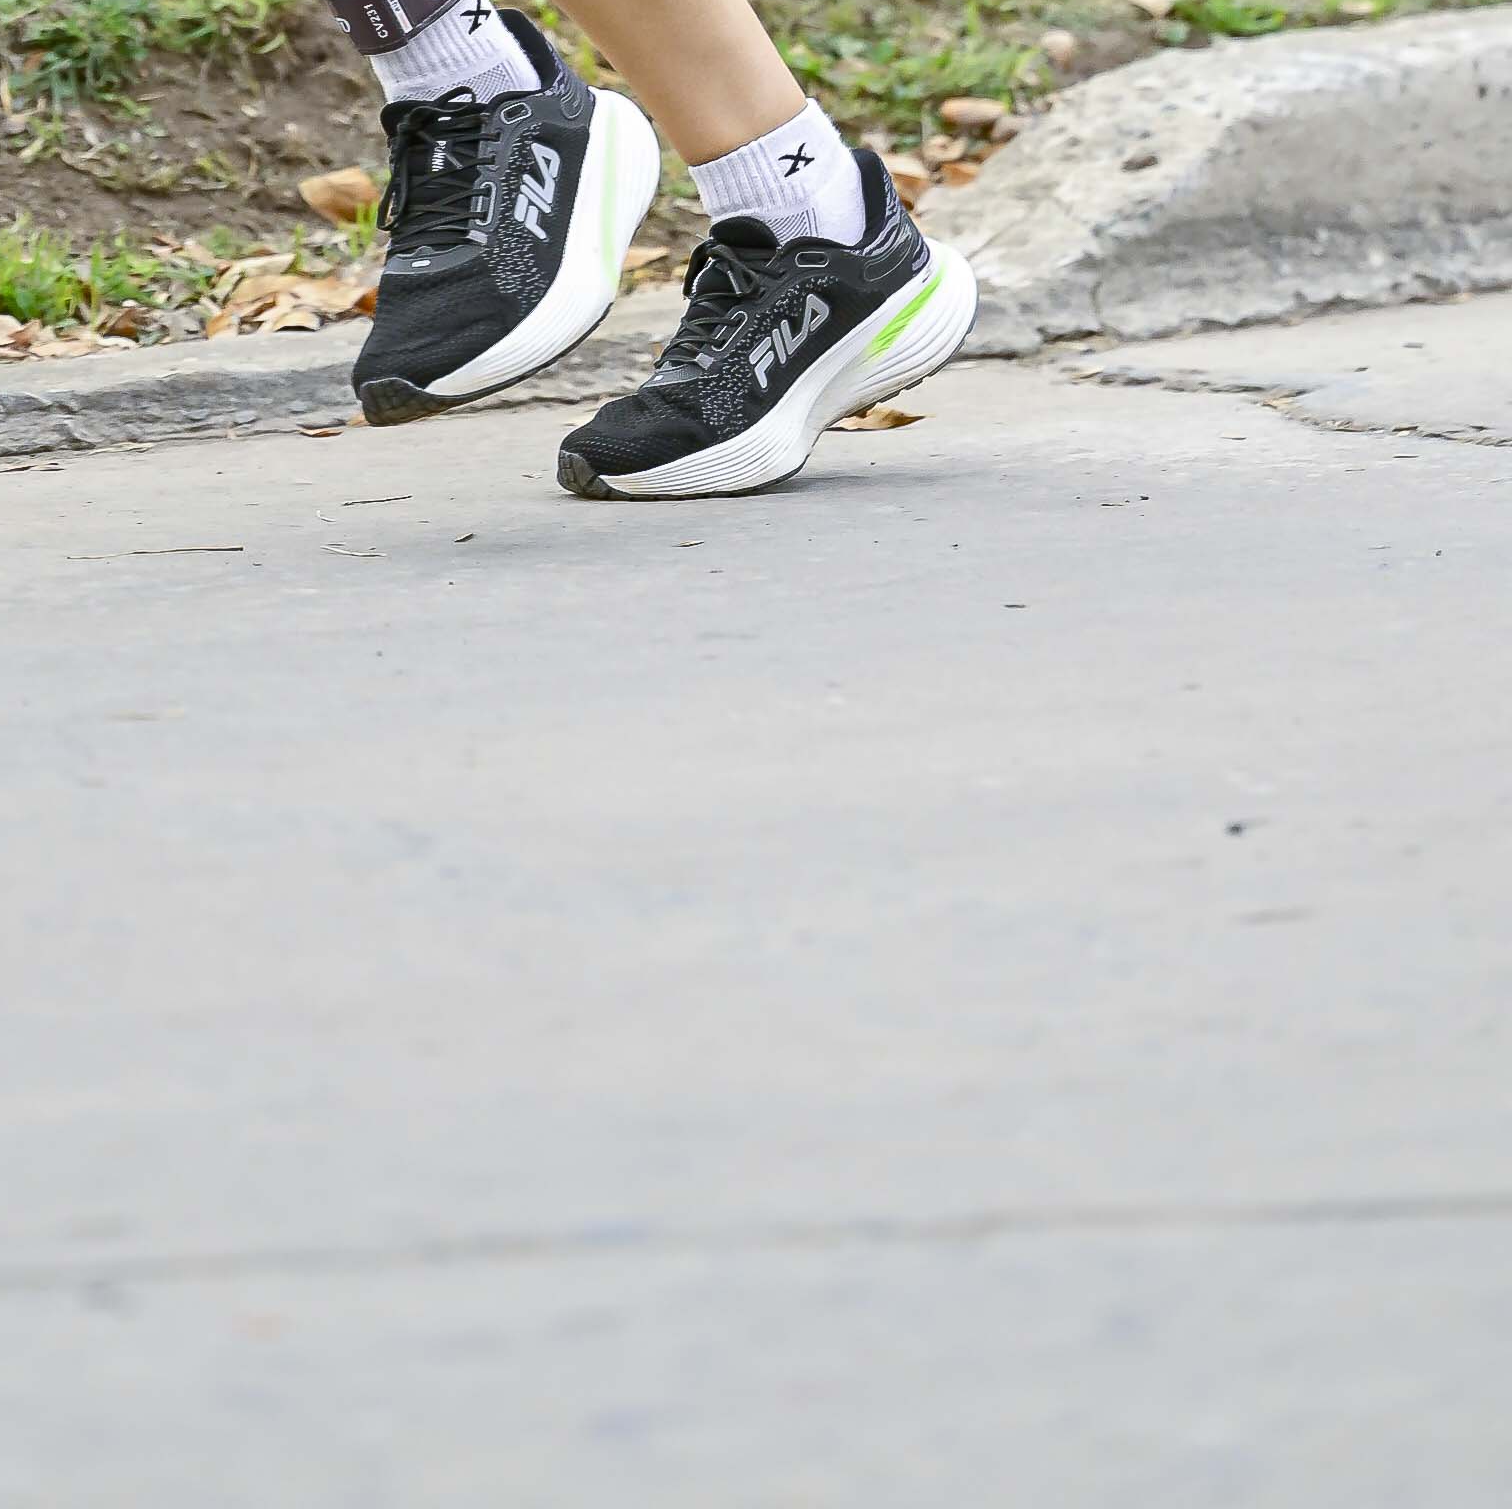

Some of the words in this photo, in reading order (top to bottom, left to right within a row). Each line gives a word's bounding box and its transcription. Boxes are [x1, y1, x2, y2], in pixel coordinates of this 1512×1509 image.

[363, 4, 388, 39] CV231
[514, 142, 561, 240] FILA
[749, 293, 830, 389] FILA
